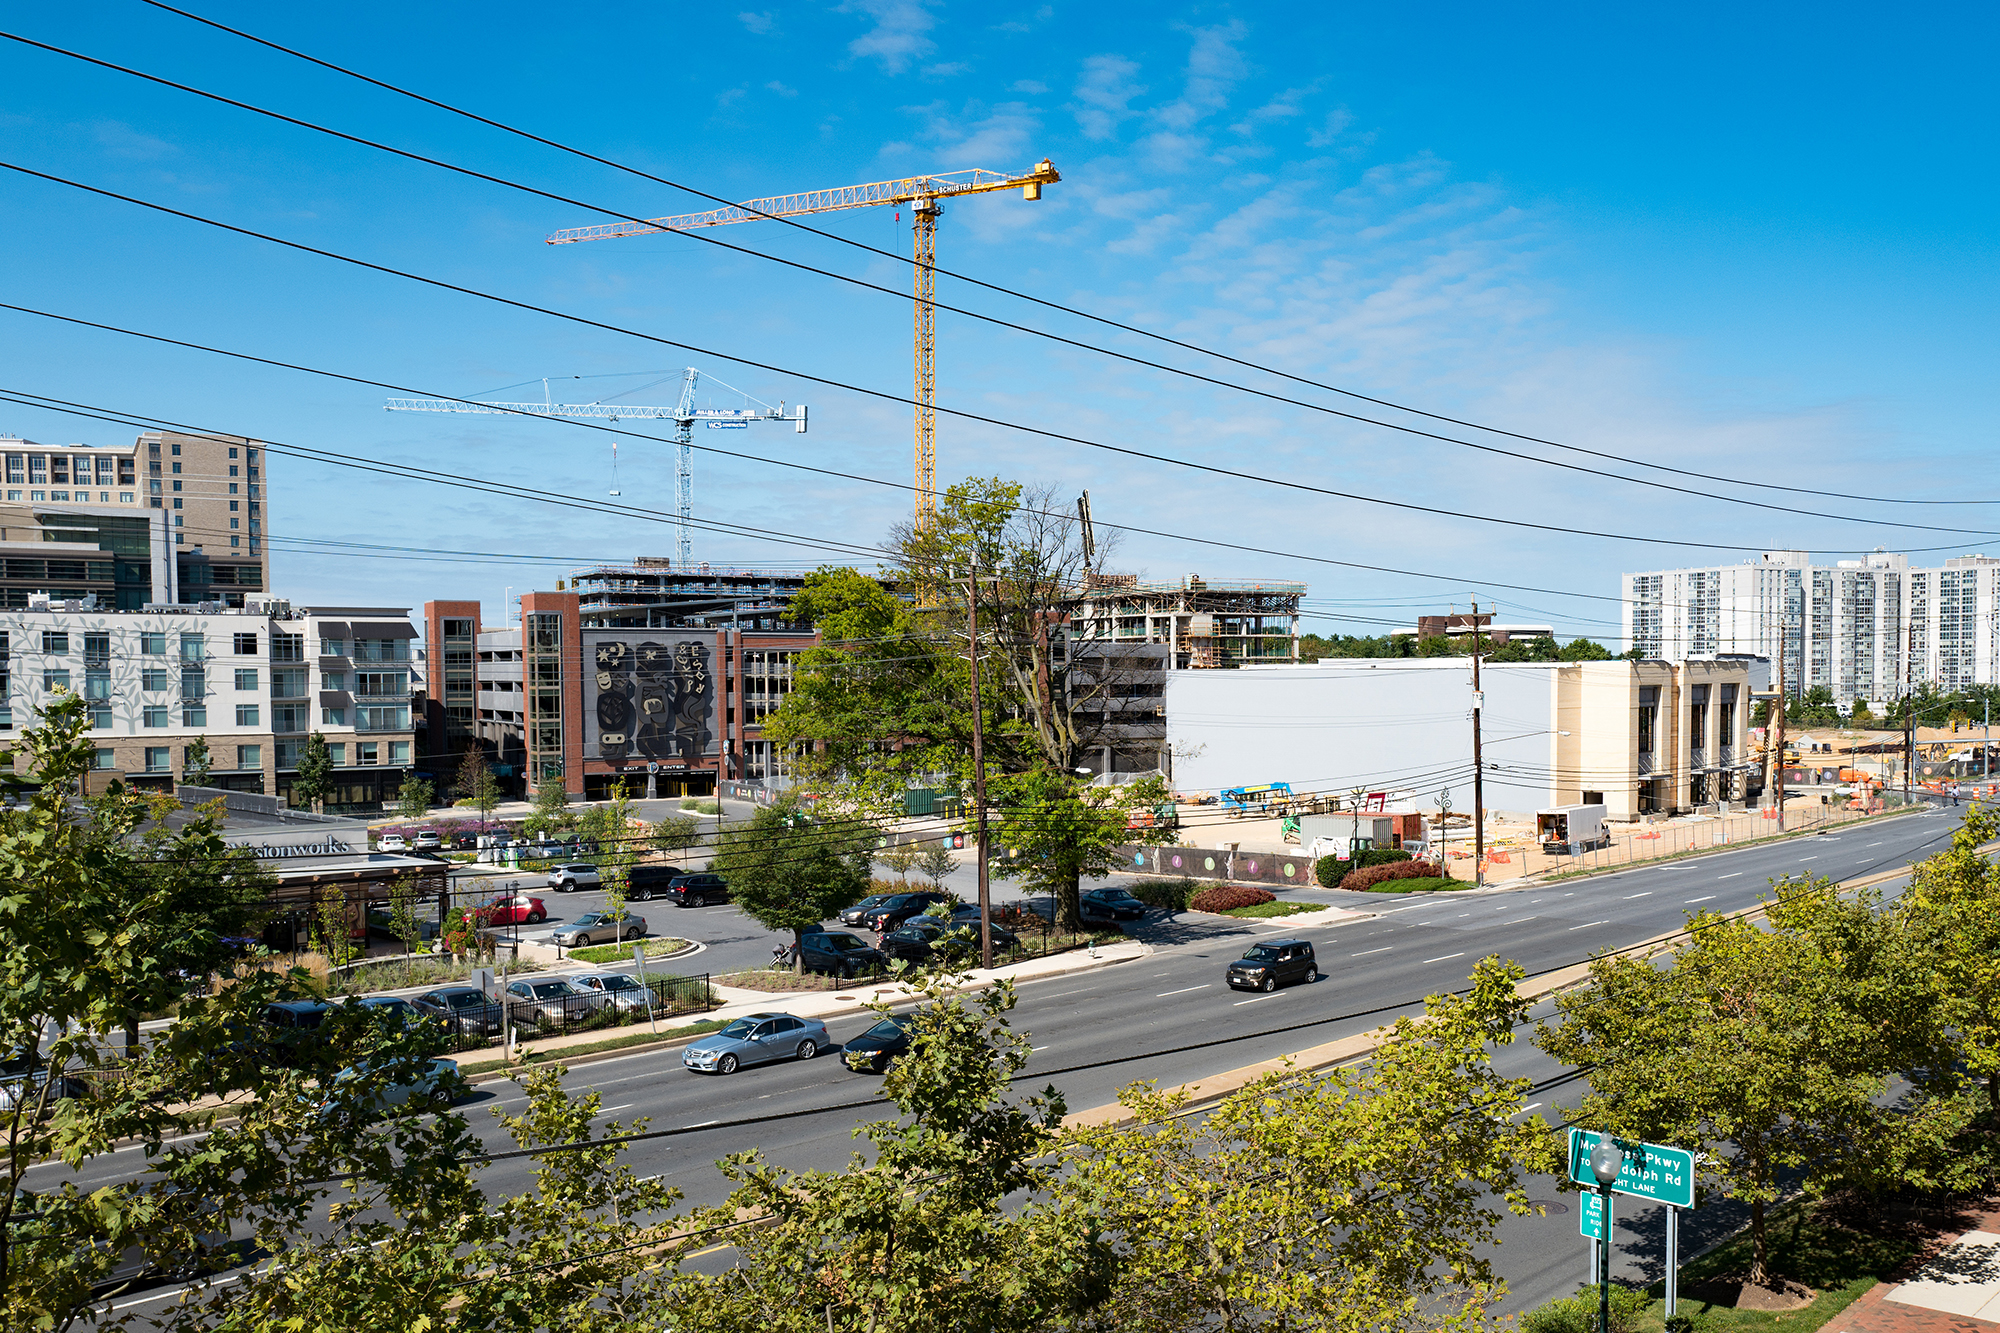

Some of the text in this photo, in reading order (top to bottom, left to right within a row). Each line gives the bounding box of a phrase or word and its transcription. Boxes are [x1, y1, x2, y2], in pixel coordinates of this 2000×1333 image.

[938, 183, 972, 193] SCHUSTER
[1645, 1152, 1680, 1172] Pkwy
[1665, 1172, 1681, 1187] Rd
[1632, 1182, 1656, 1194] LANE
[1586, 1209, 1600, 1219] PARK
